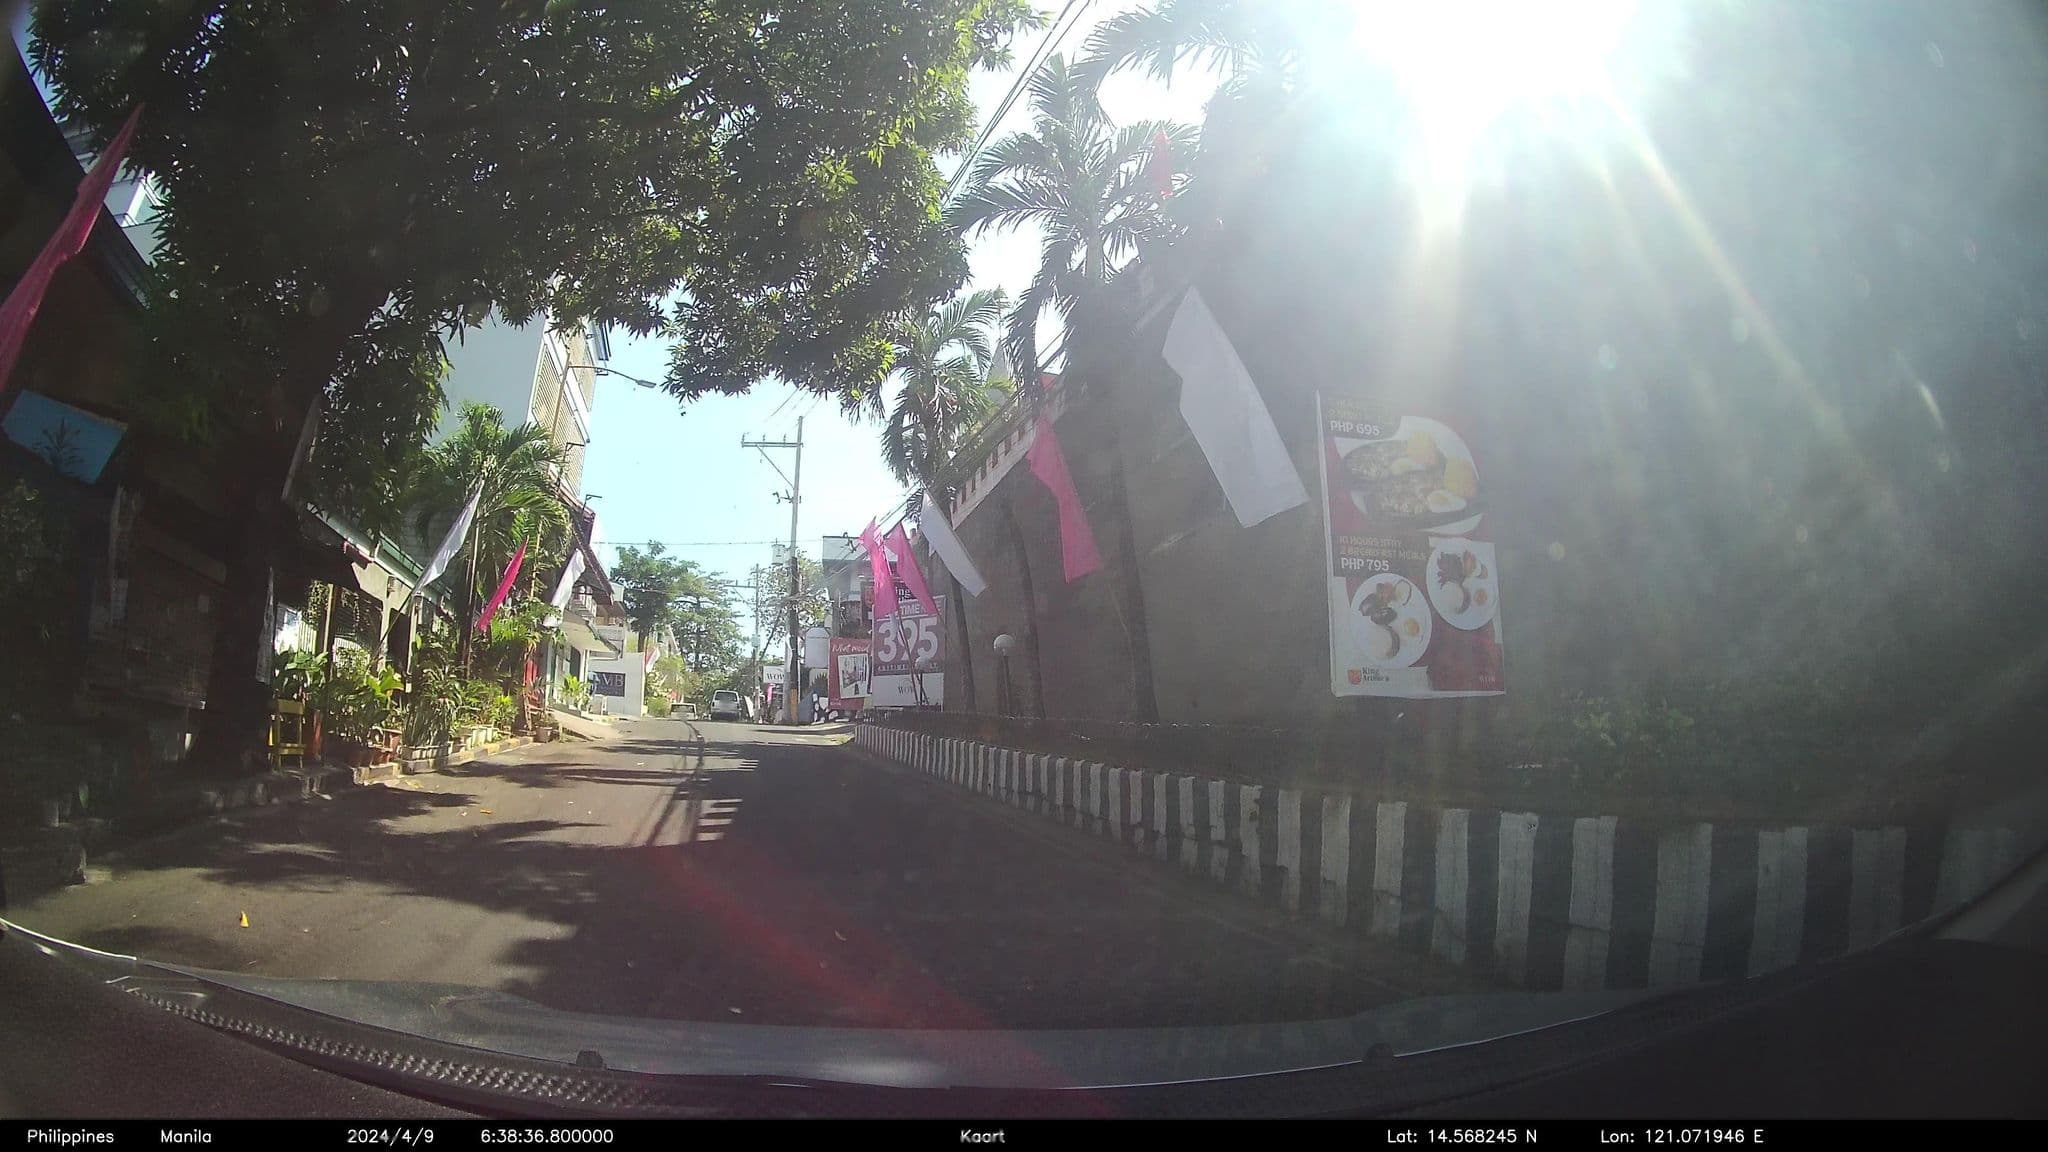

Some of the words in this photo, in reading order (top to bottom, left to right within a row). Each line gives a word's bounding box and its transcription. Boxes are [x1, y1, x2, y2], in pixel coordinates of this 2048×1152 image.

[1330, 420, 1353, 433] PHP
[1356, 423, 1380, 436] 695
[1350, 536, 1377, 547] HOURS
[1340, 557, 1364, 569] PHP
[1367, 558, 1389, 571] 795
[878, 617, 938, 662] 395
